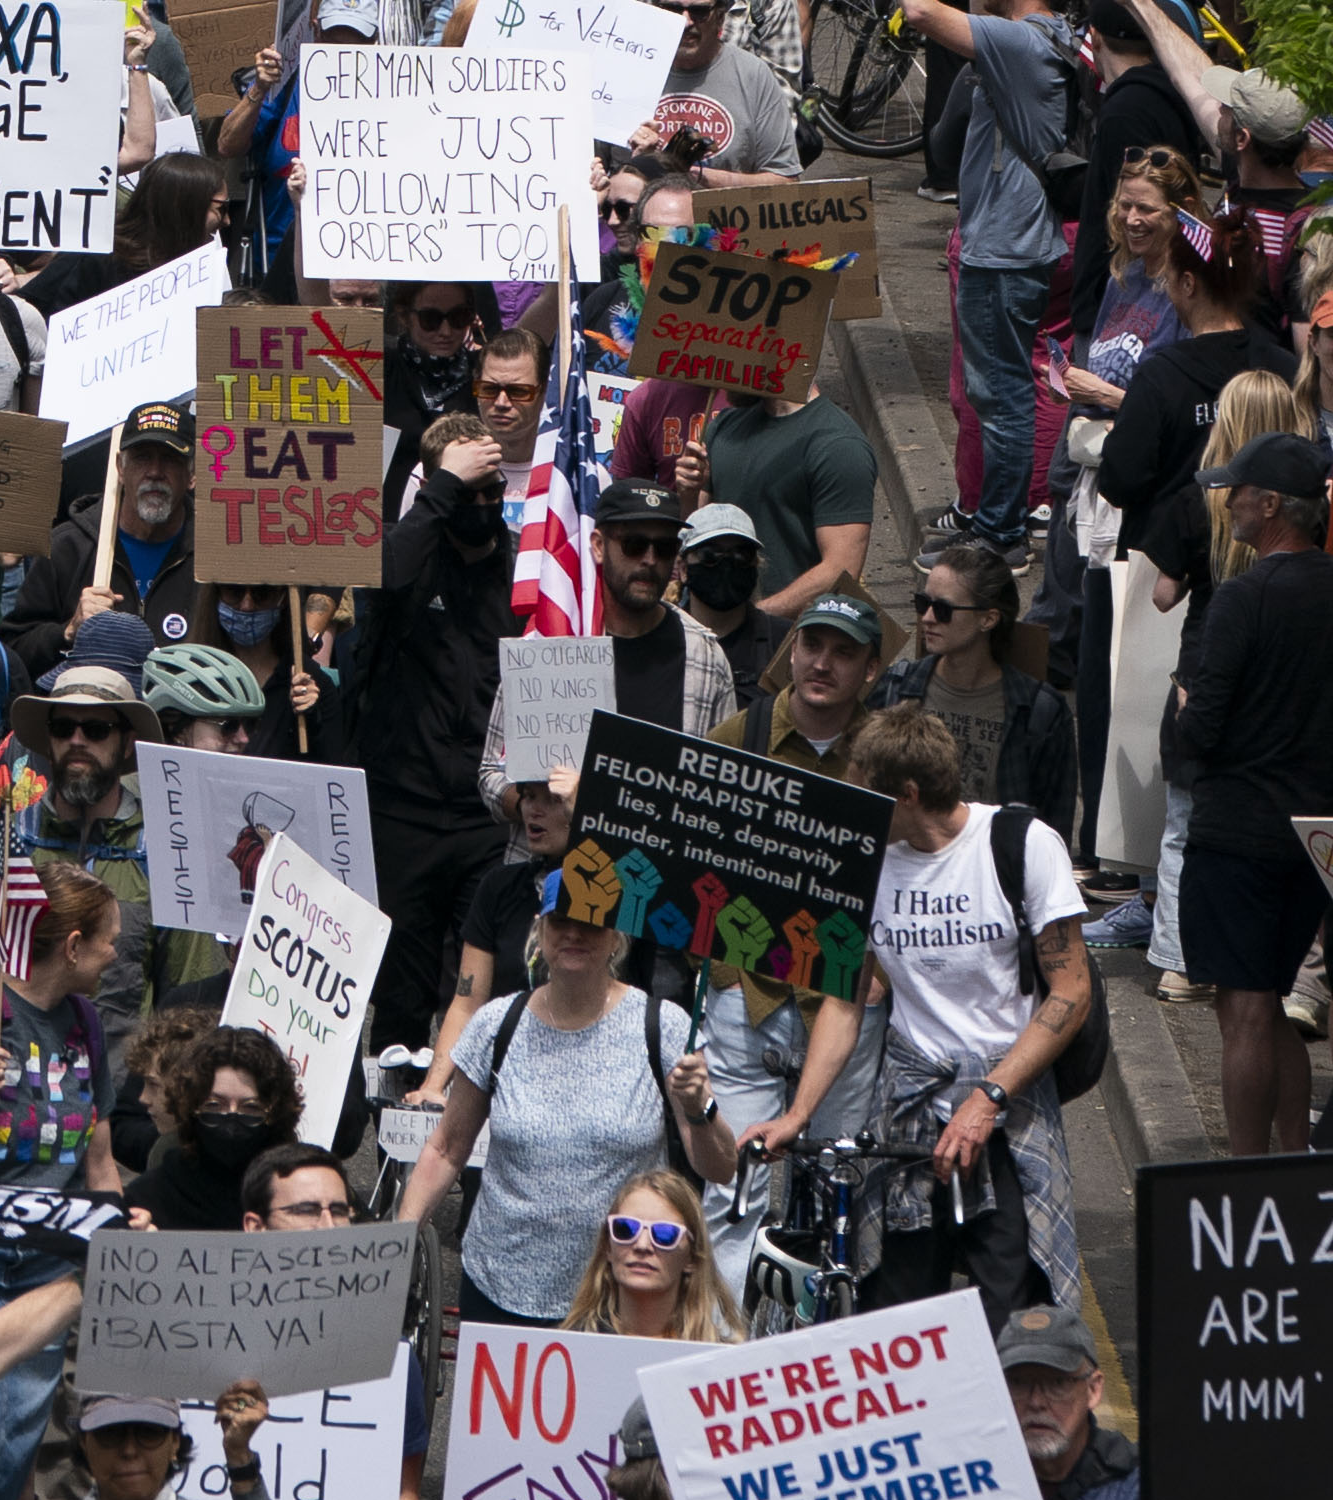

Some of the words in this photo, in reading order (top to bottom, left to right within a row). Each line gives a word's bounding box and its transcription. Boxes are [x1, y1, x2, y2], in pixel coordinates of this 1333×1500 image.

[893, 889, 901, 914] I
[911, 889, 969, 915] Hate
[870, 917, 1003, 954] Capitalism
[689, 1354, 837, 1419] WE'RE
[849, 1326, 949, 1386] NOT
[705, 1381, 928, 1458] RADICAL.
[816, 1433, 922, 1489] JUST
